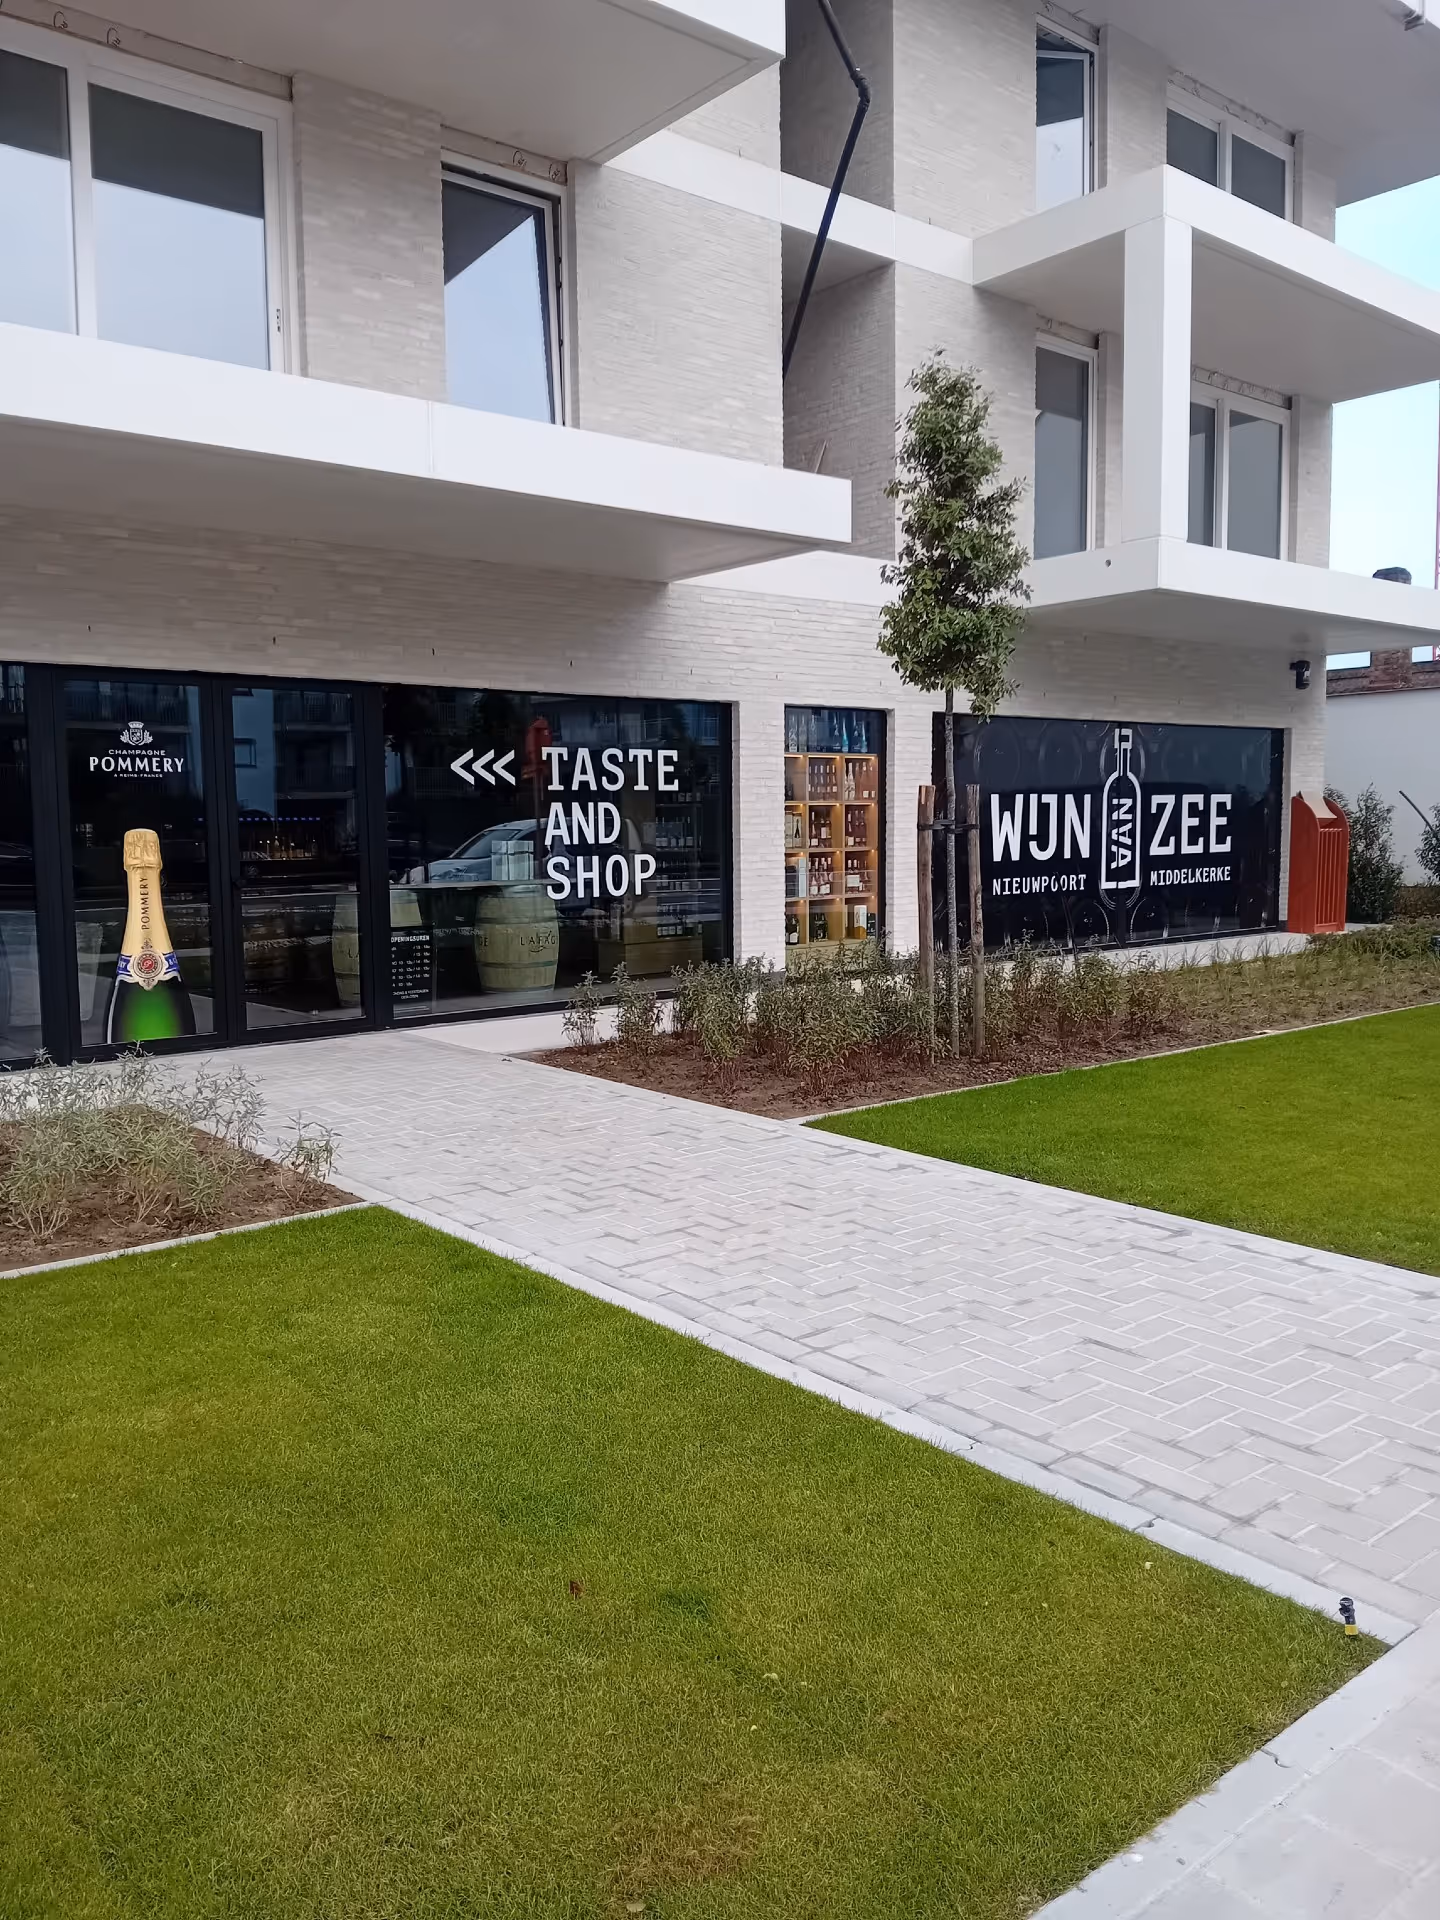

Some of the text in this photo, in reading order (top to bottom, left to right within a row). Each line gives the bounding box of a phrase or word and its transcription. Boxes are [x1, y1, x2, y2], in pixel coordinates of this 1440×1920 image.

[89, 756, 184, 773] POMMERY
[541, 746, 679, 791] TASTE
[544, 801, 621, 846] AND
[990, 793, 1092, 862] WIJN
[1149, 793, 1233, 856] ZEE
[546, 853, 656, 901] SHOP
[992, 874, 1087, 896] NIEUWPOORT
[1149, 866, 1231, 886] MIDDELKERKE
[139, 876, 150, 931] POMMERY
